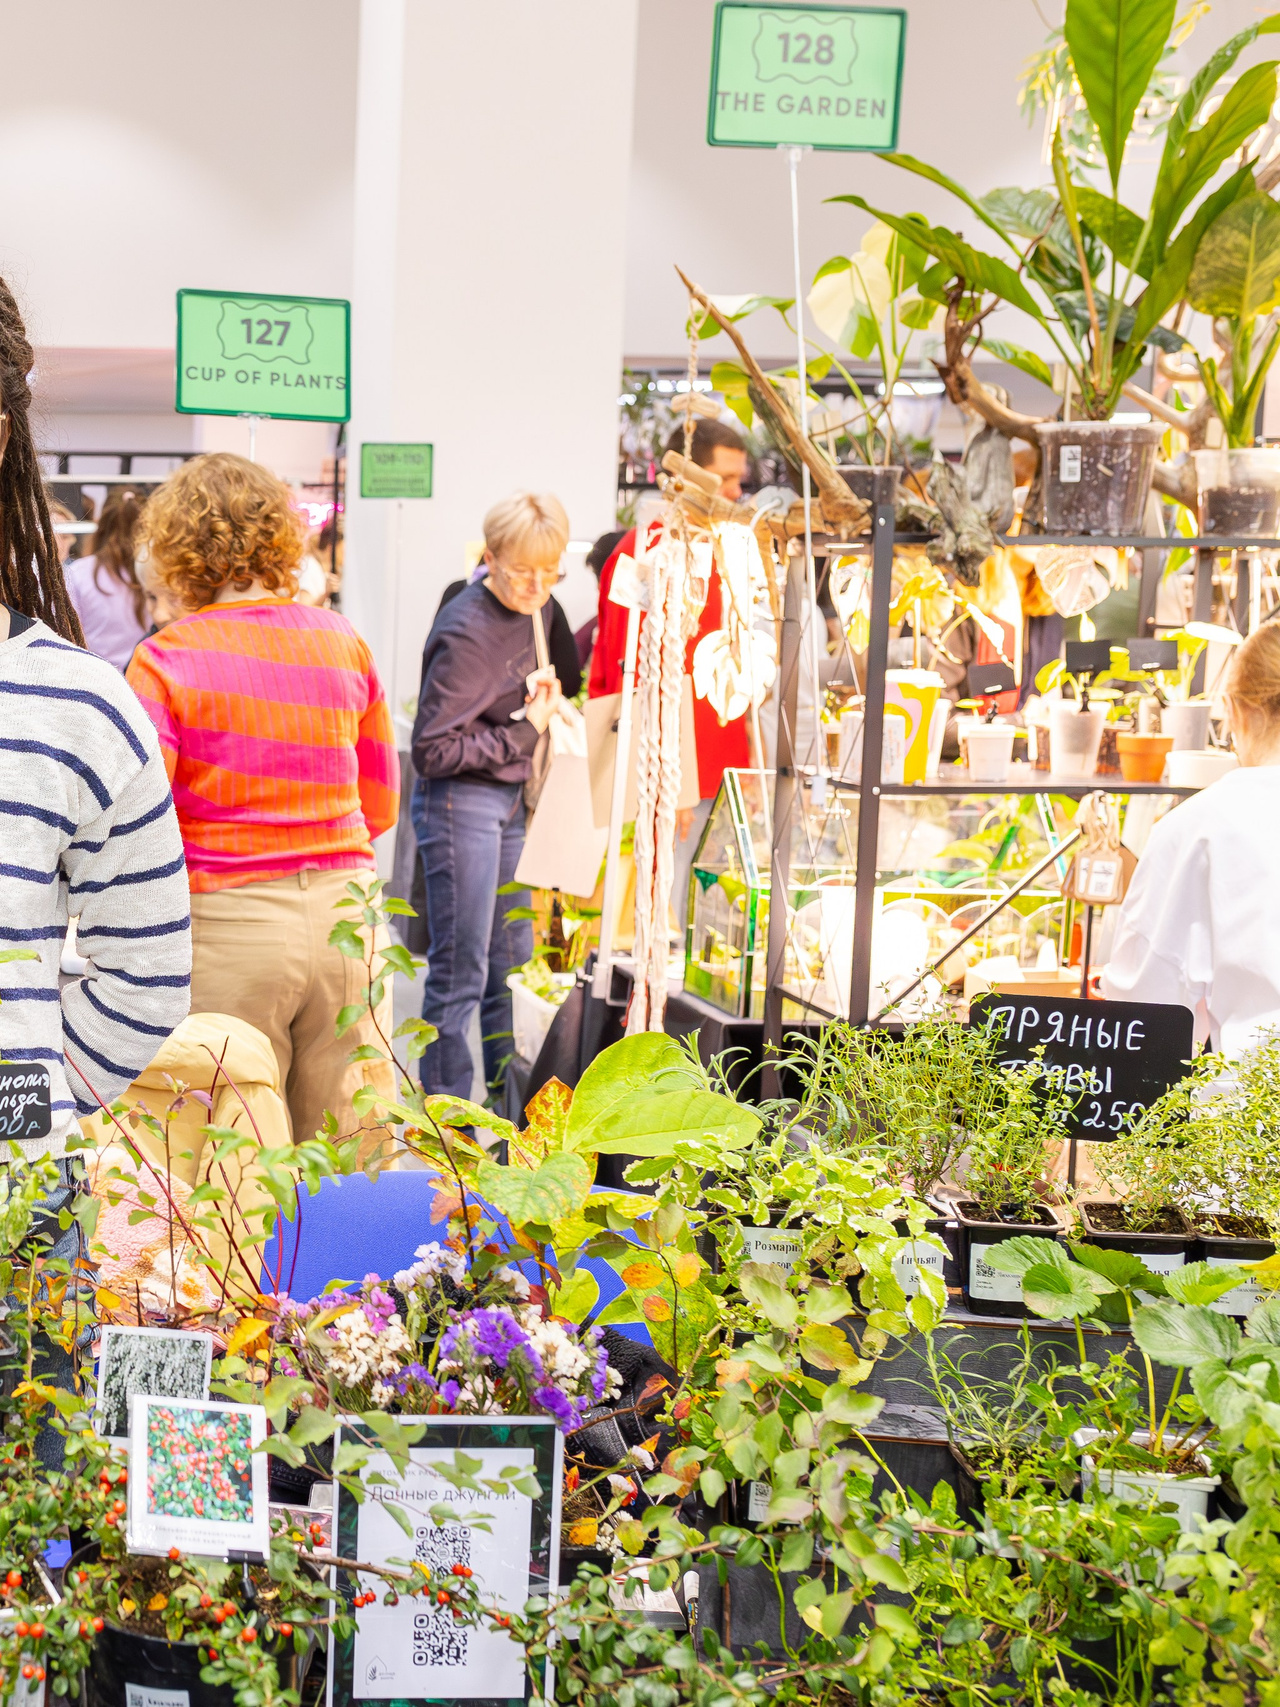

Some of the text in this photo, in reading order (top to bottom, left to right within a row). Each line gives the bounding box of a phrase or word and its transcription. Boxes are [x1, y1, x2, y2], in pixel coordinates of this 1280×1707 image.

[777, 32, 836, 66] 128
[717, 90, 887, 119] THE GARDEN
[240, 318, 291, 347] 127
[185, 366, 347, 390] CUP OF PLANTS
[986, 1005, 1146, 1051] ПРЯНЫЕ
[370, 1486, 439, 1502] Дачные
